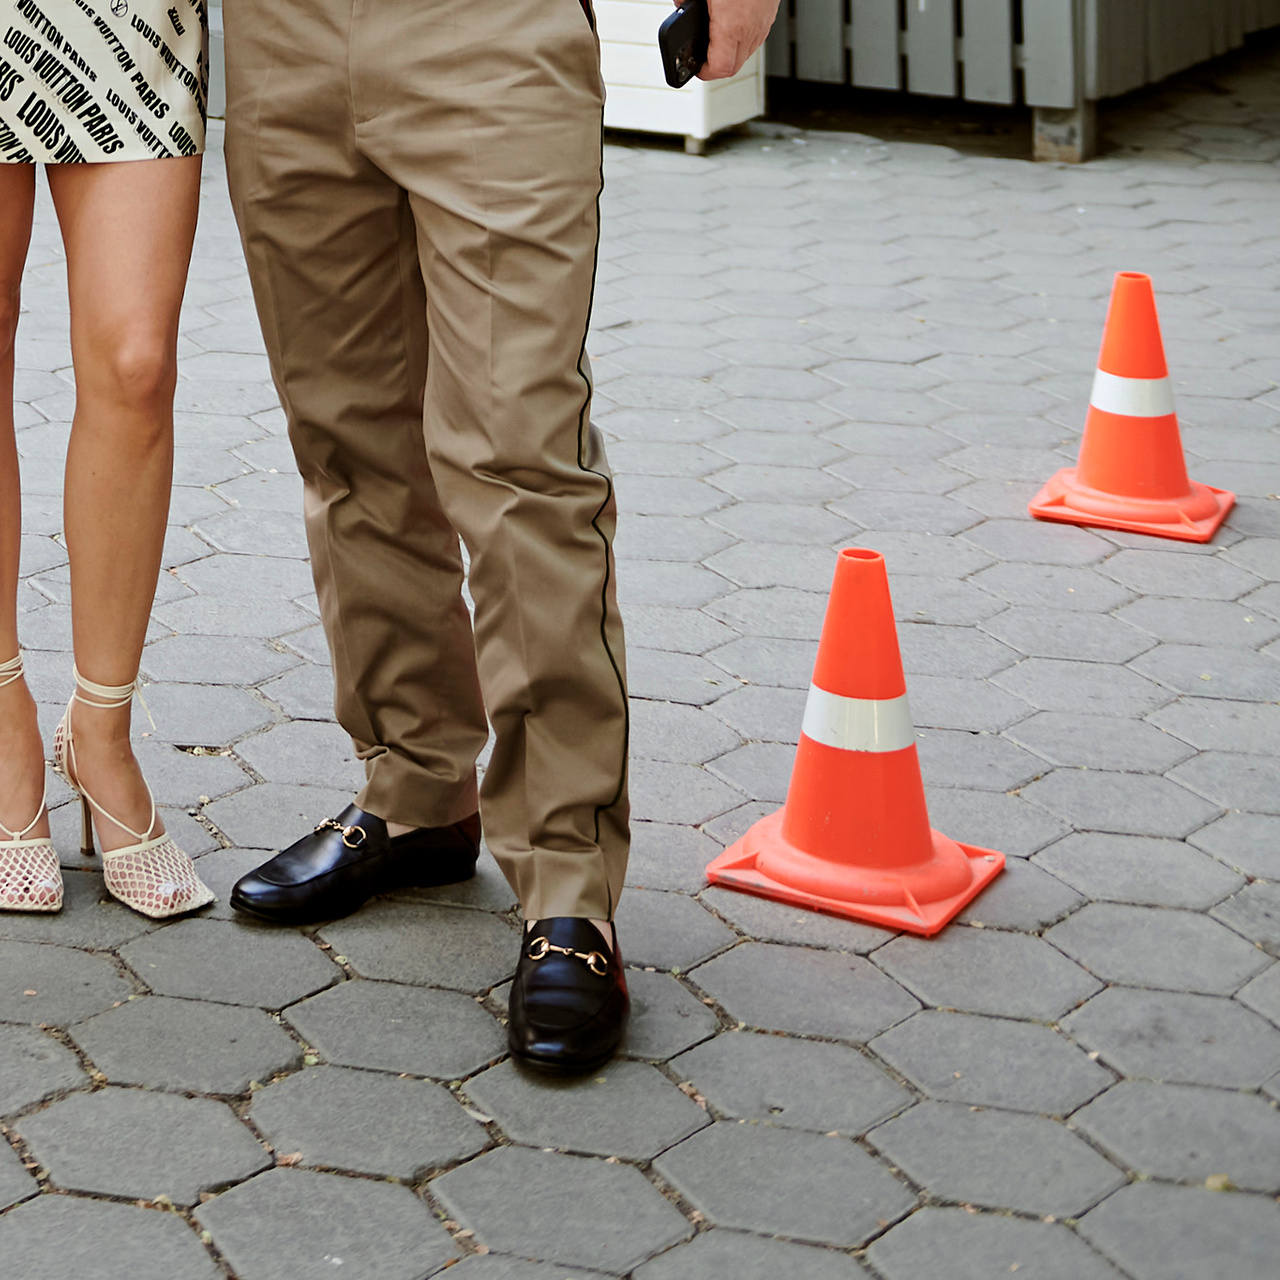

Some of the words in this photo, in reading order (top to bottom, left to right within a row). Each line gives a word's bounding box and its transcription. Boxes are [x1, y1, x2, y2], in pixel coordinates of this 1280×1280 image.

[130, 13, 162, 49] LOUIS
[3, 26, 42, 65] LOUIS
[31, 49, 94, 114] VUITTON
[76, 102, 125, 155] PARIS
[93, 15, 137, 74] VUITTON
[130, 71, 171, 119] PARIS
[16, 91, 66, 150] LOUIS
[105, 88, 139, 125] LOUIS
